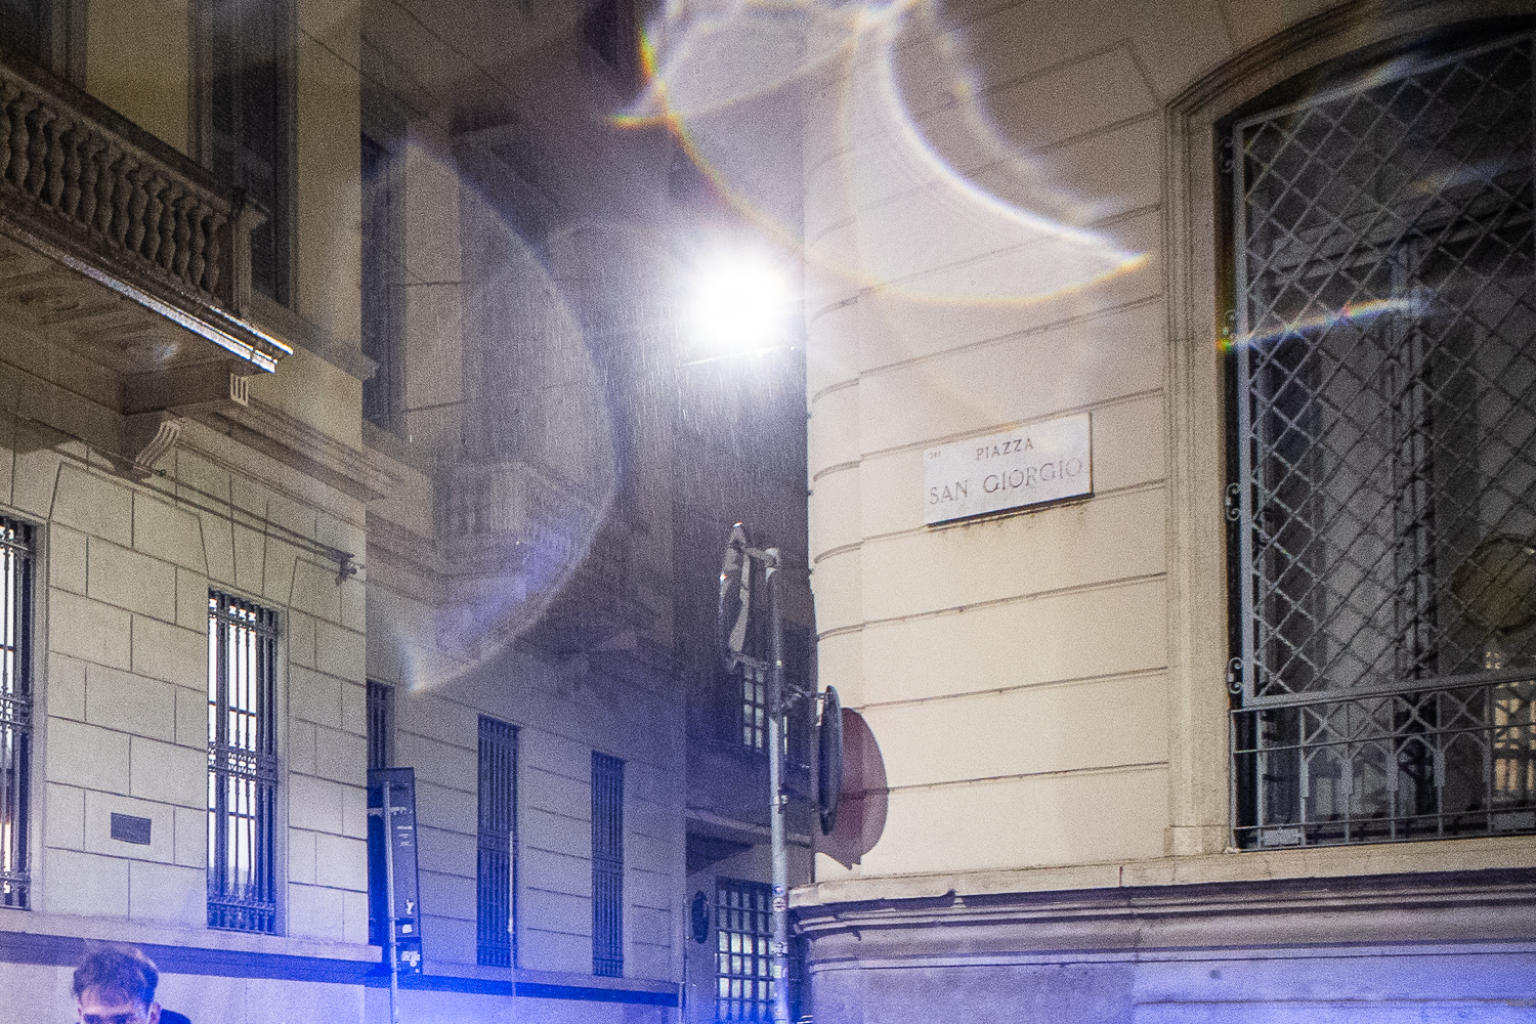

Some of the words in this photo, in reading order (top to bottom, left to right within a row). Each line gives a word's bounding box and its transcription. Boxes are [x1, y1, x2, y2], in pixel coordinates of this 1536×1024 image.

[976, 437, 1034, 461] PIAZZA
[929, 479, 968, 504] SAN
[983, 457, 1082, 493] GIORGIO
